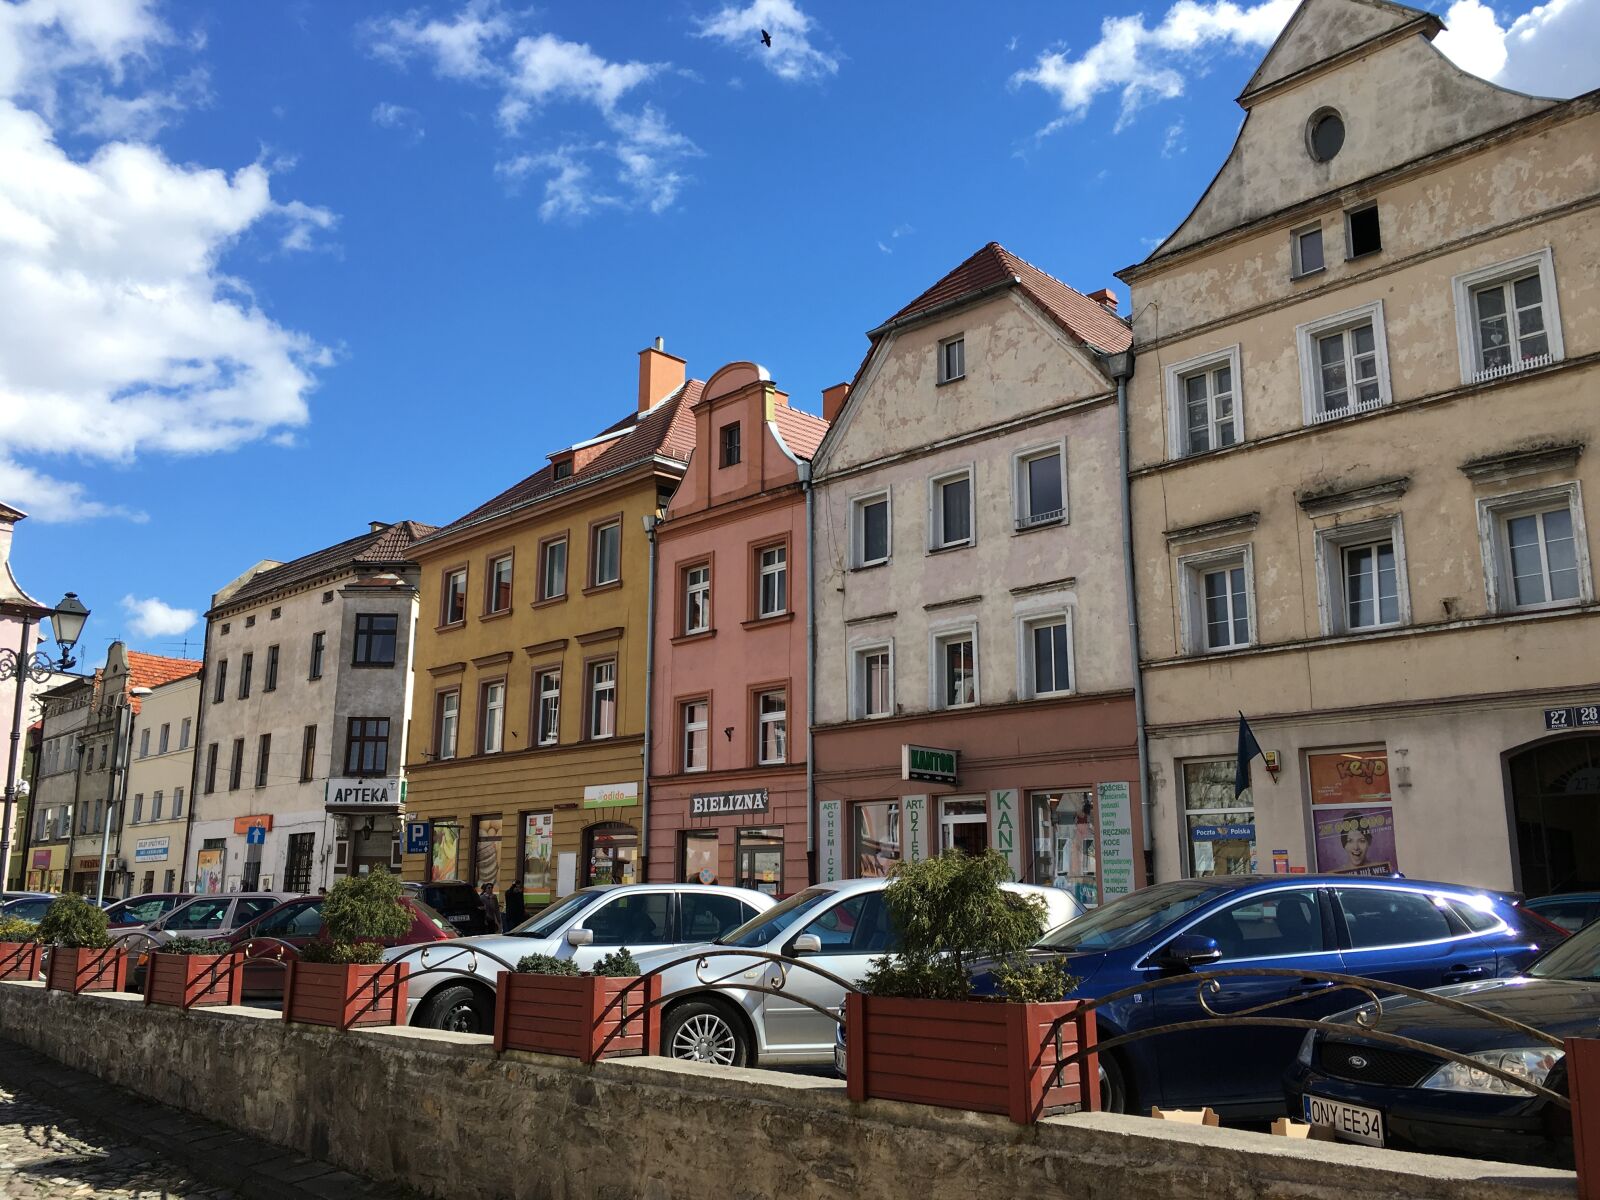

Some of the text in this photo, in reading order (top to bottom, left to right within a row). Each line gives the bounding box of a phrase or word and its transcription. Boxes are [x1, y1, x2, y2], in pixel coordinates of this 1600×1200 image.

[1550, 710, 1566, 724] 27
[1580, 706, 1597, 720] 28
[910, 750, 953, 773] KANTOR
[334, 788, 389, 802] APTEKA
[693, 793, 764, 813] BIELIZNA
[906, 800, 924, 809] ART.
[412, 824, 424, 842] P
[1312, 1100, 1380, 1139] ONY EE34
